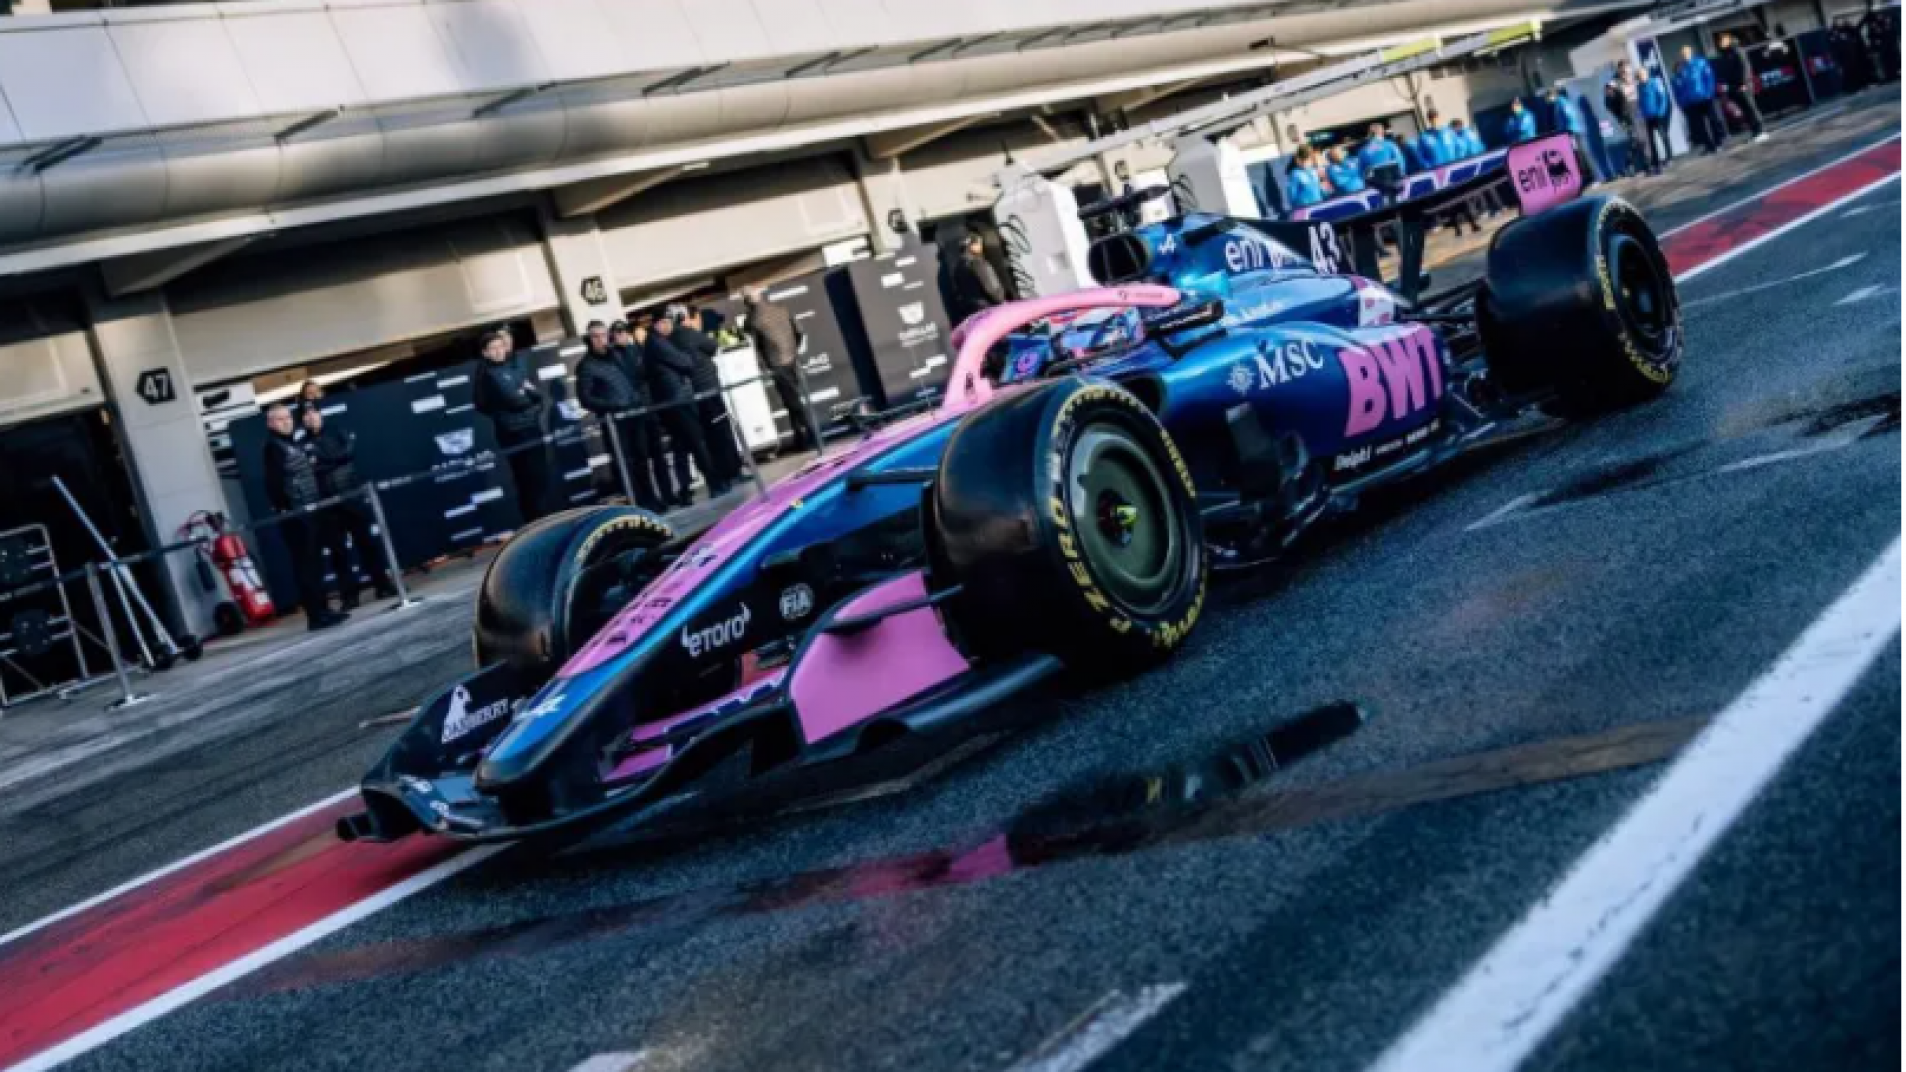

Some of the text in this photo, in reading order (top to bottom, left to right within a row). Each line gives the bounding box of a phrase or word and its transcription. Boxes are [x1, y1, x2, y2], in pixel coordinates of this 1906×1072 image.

[1518, 155, 1547, 193] eni
[1308, 221, 1340, 275] 43
[1254, 337, 1324, 389] MSC
[144, 374, 169, 400] 47
